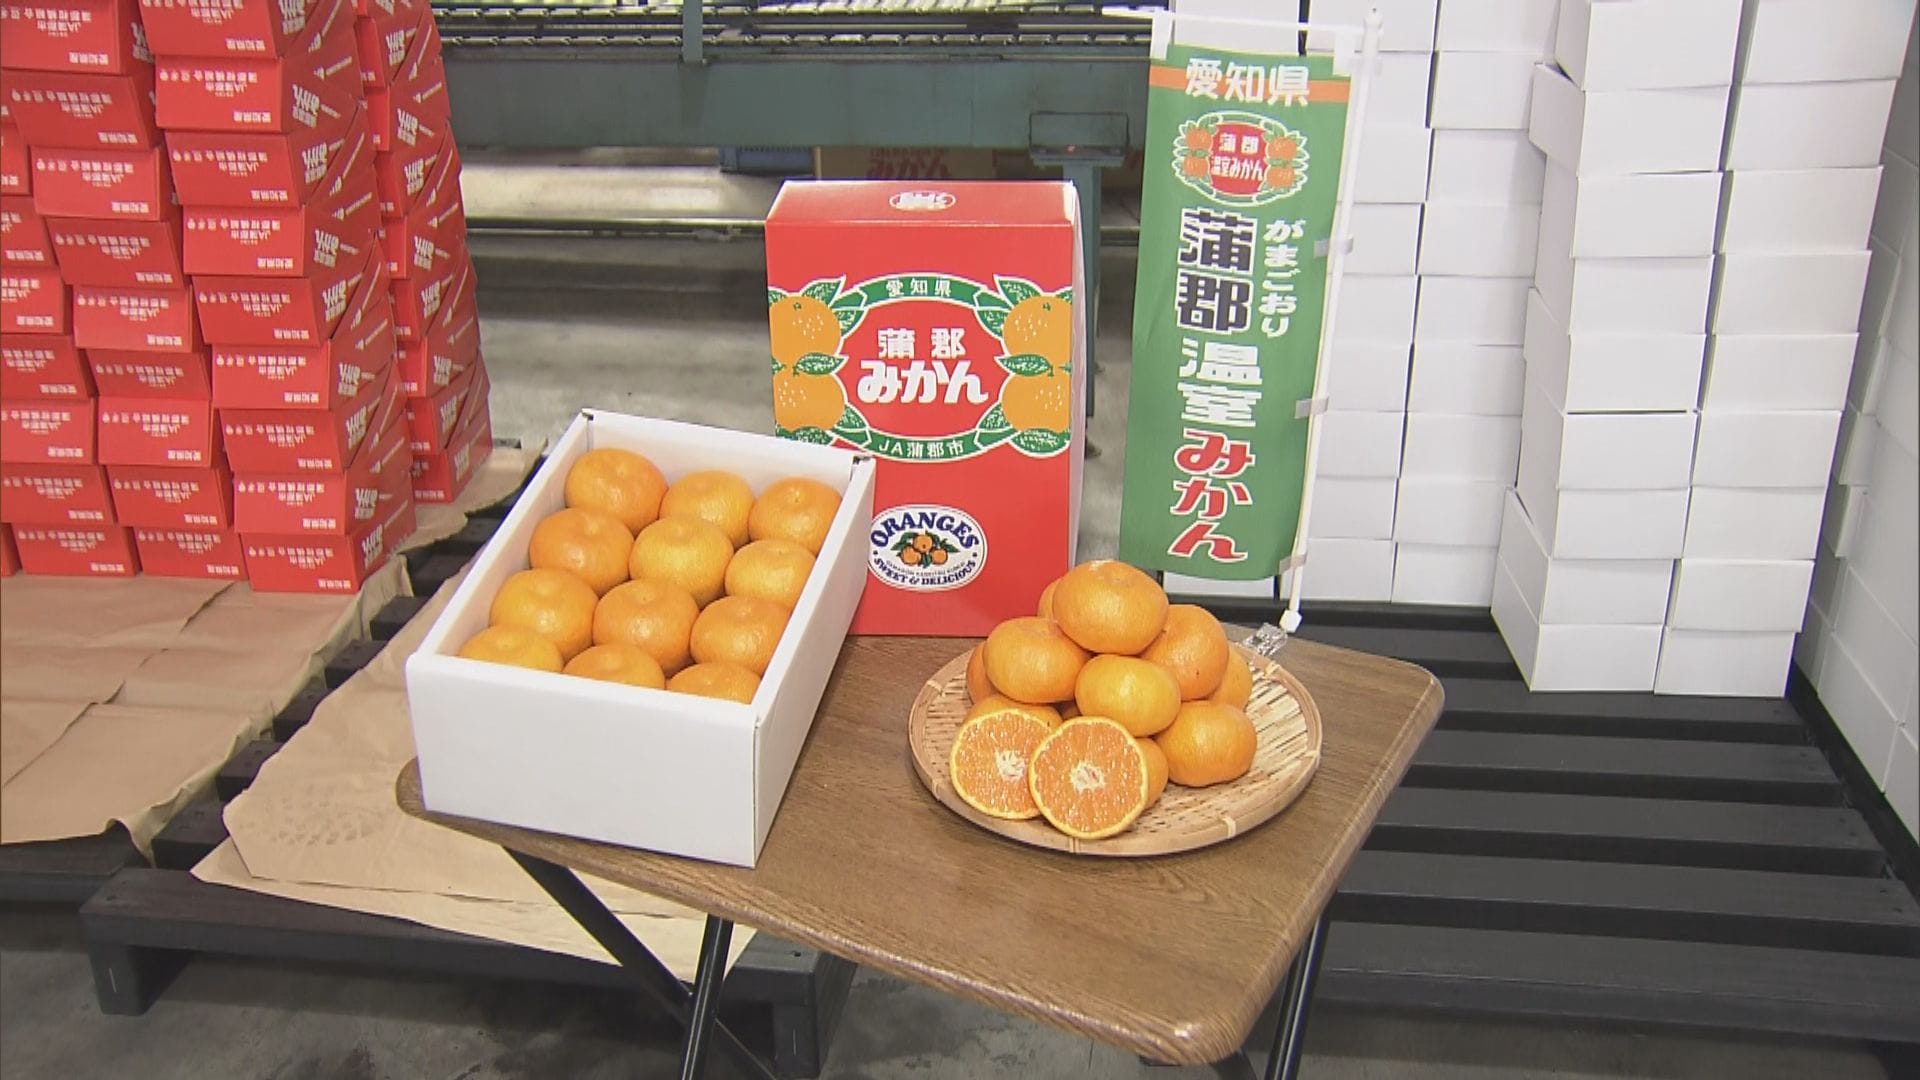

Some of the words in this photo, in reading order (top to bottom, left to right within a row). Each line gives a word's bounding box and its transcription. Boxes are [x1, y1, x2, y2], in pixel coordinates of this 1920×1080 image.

[1185, 57, 1310, 107] 愛知県
[1218, 132, 1259, 151] 蒲郡
[1210, 155, 1266, 182] 温室みかん
[886, 278, 952, 298] 愛知県
[1258, 218, 1306, 339] がまごおり
[878, 328, 966, 359] 蒲郡
[858, 360, 988, 404] みかん
[879, 441, 965, 459] JA蒲郡市
[870, 511, 980, 549] ORANGES
[873, 558, 909, 582] SWEET
[909, 574, 921, 585] &
[921, 560, 976, 586] DELICIOUS
